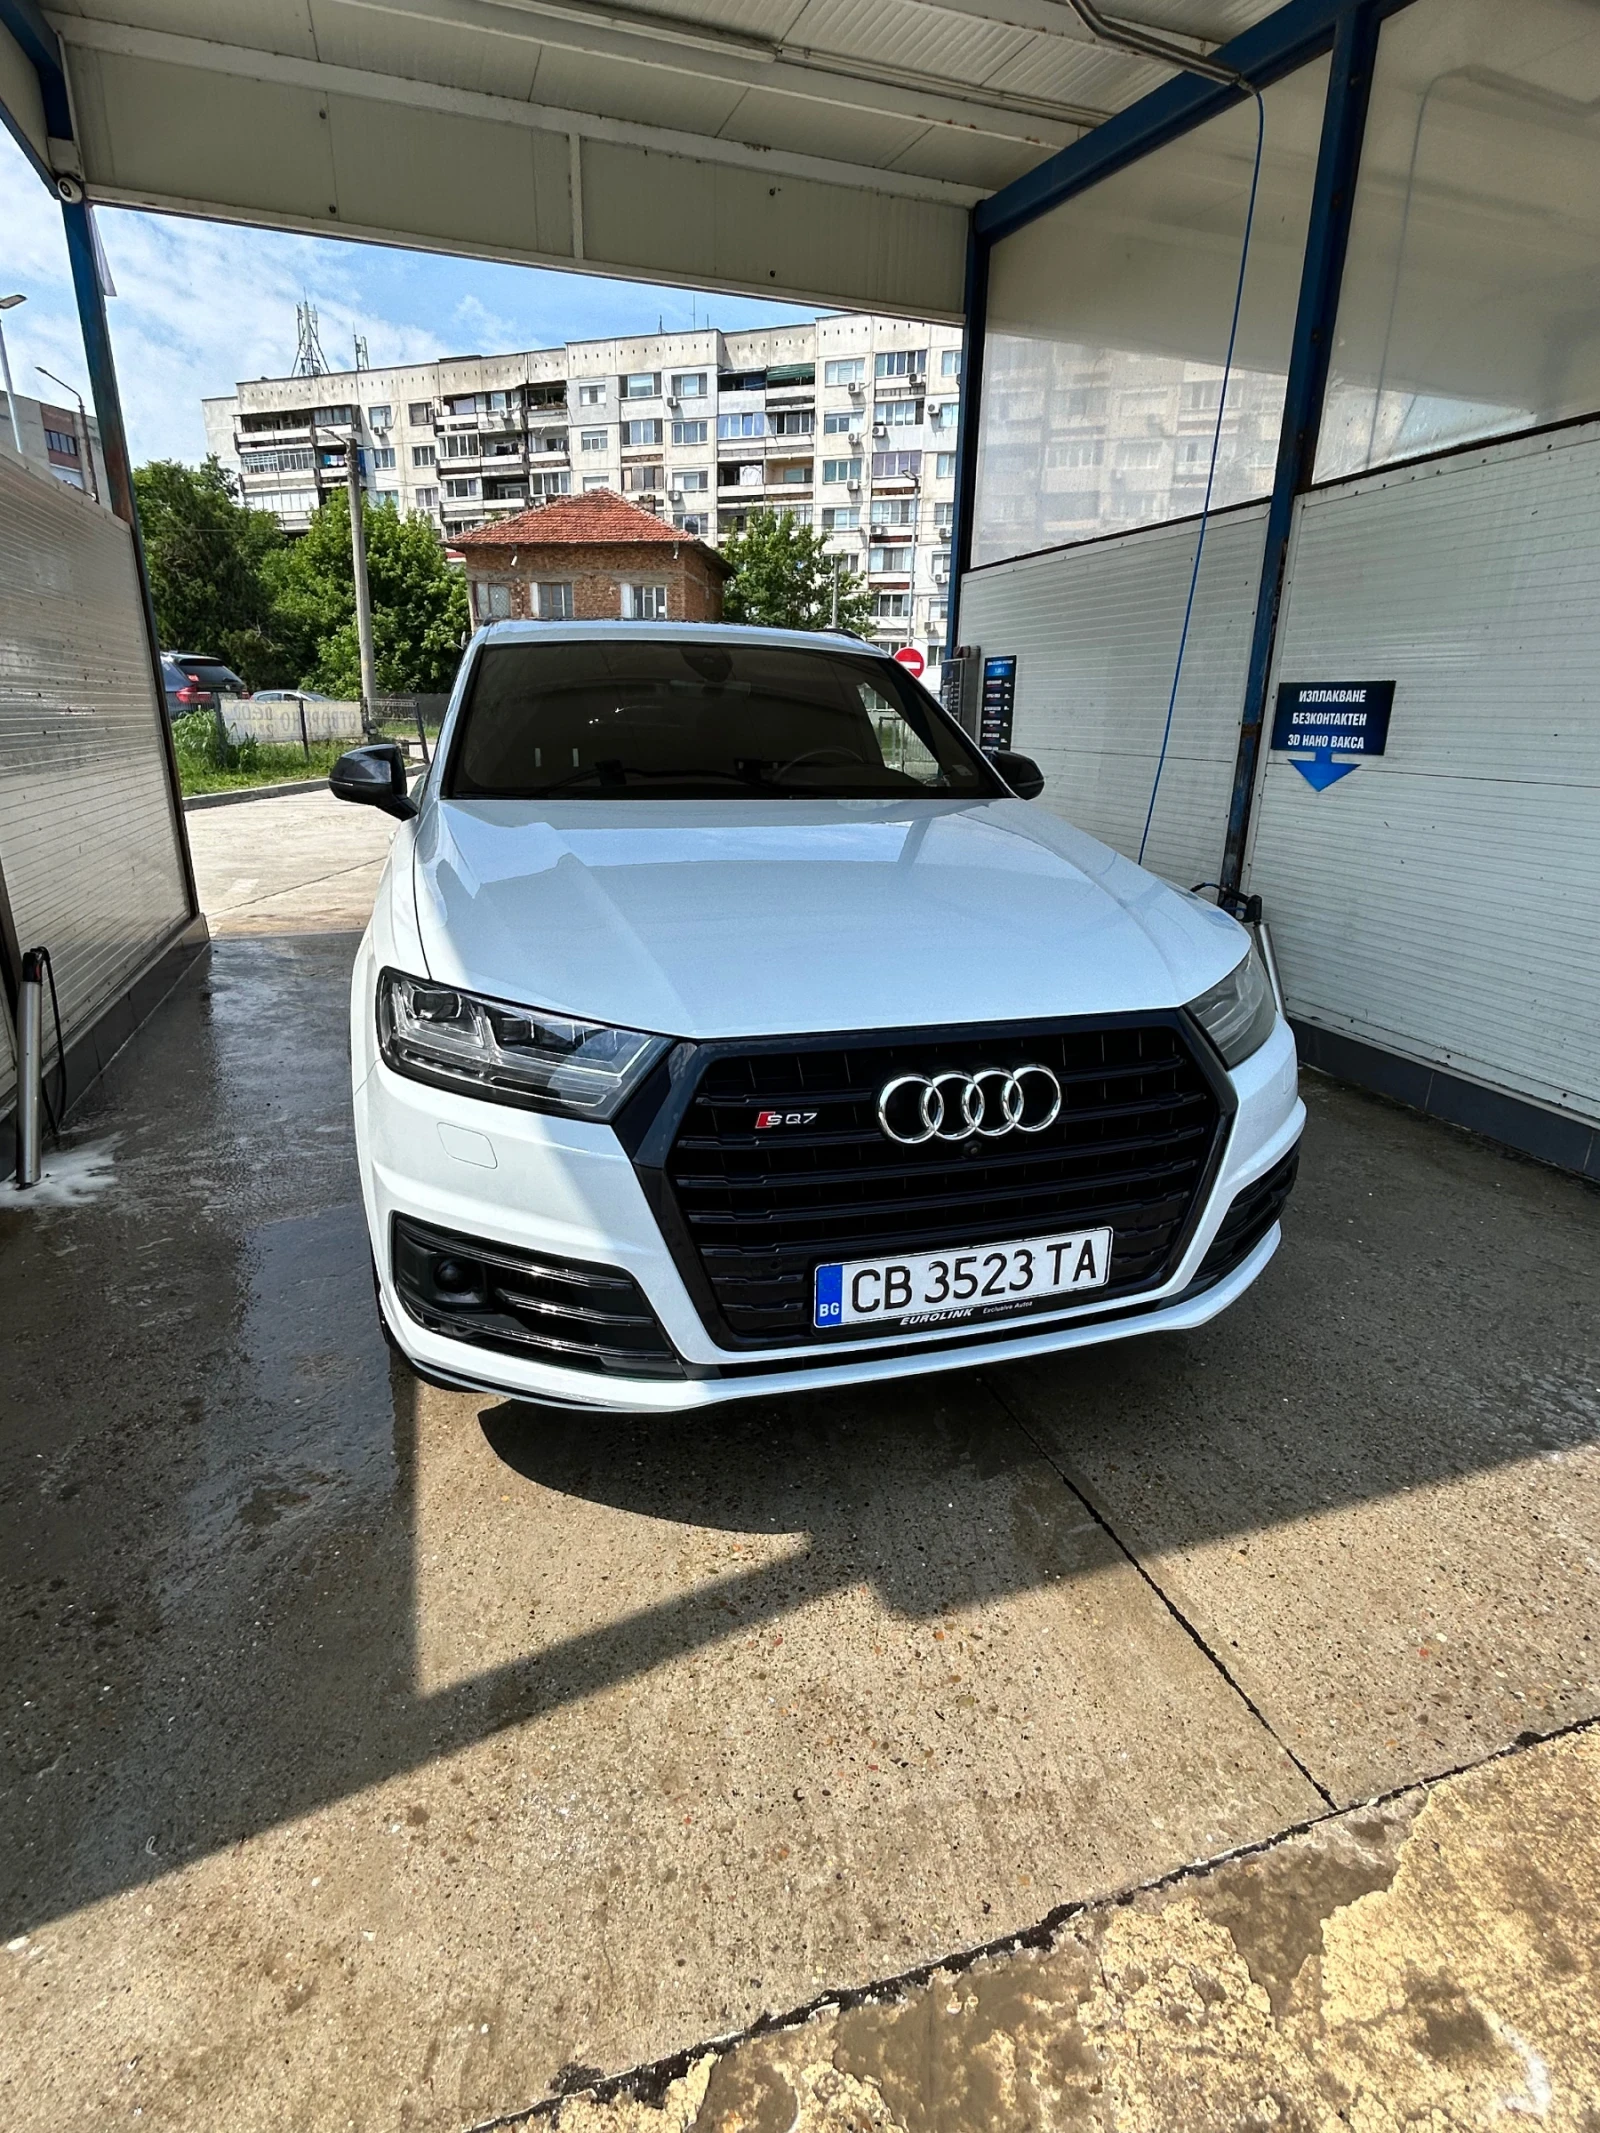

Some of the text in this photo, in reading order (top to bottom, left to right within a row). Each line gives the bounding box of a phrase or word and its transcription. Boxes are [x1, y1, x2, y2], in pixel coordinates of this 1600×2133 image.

[1299, 690, 1367, 702] ИЗПЛАКВАНЕ
[1292, 712, 1367, 725] БЕЗКОНТАКТЕН
[1287, 734, 1364, 749] 3D НАНО ВАКСА
[851, 1239, 1097, 1313] CB 3523 TA
[819, 1302, 840, 1317] BG
[899, 1308, 975, 1325] EUROLINK
[983, 1304, 1013, 1314] Exclusive
